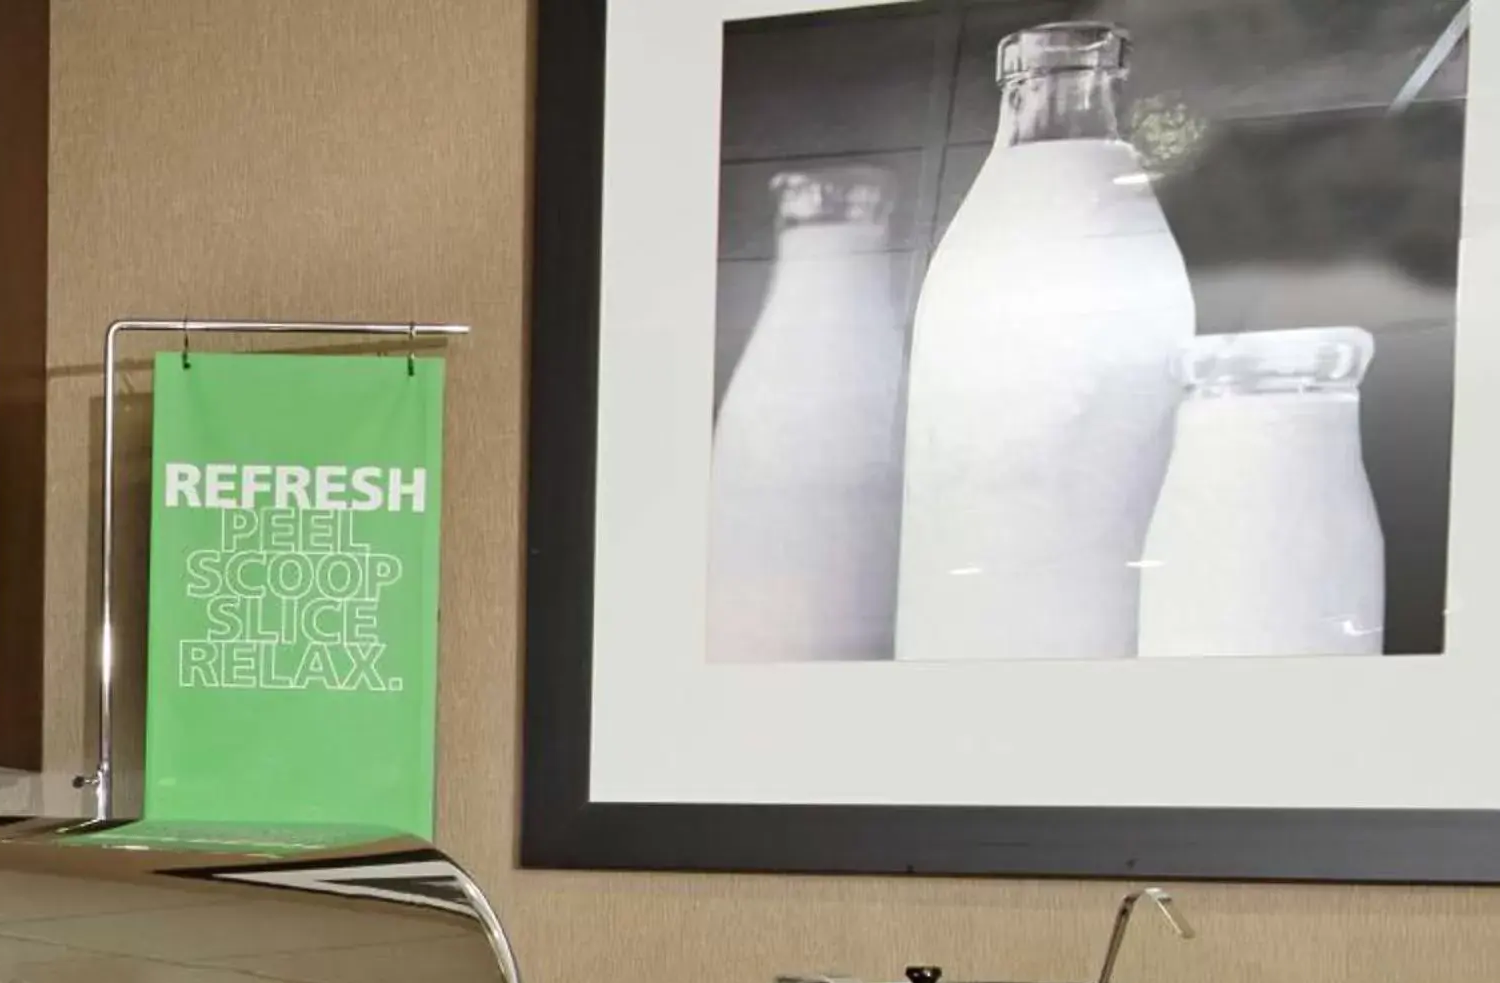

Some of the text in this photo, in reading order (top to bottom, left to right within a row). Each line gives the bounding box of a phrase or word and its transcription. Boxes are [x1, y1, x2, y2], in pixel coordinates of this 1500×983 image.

[165, 463, 426, 512] REFRESH
[221, 506, 370, 554] PEEL
[186, 550, 403, 600] SCOOP
[206, 596, 378, 646] SLICE
[179, 639, 403, 691] RELAX.
